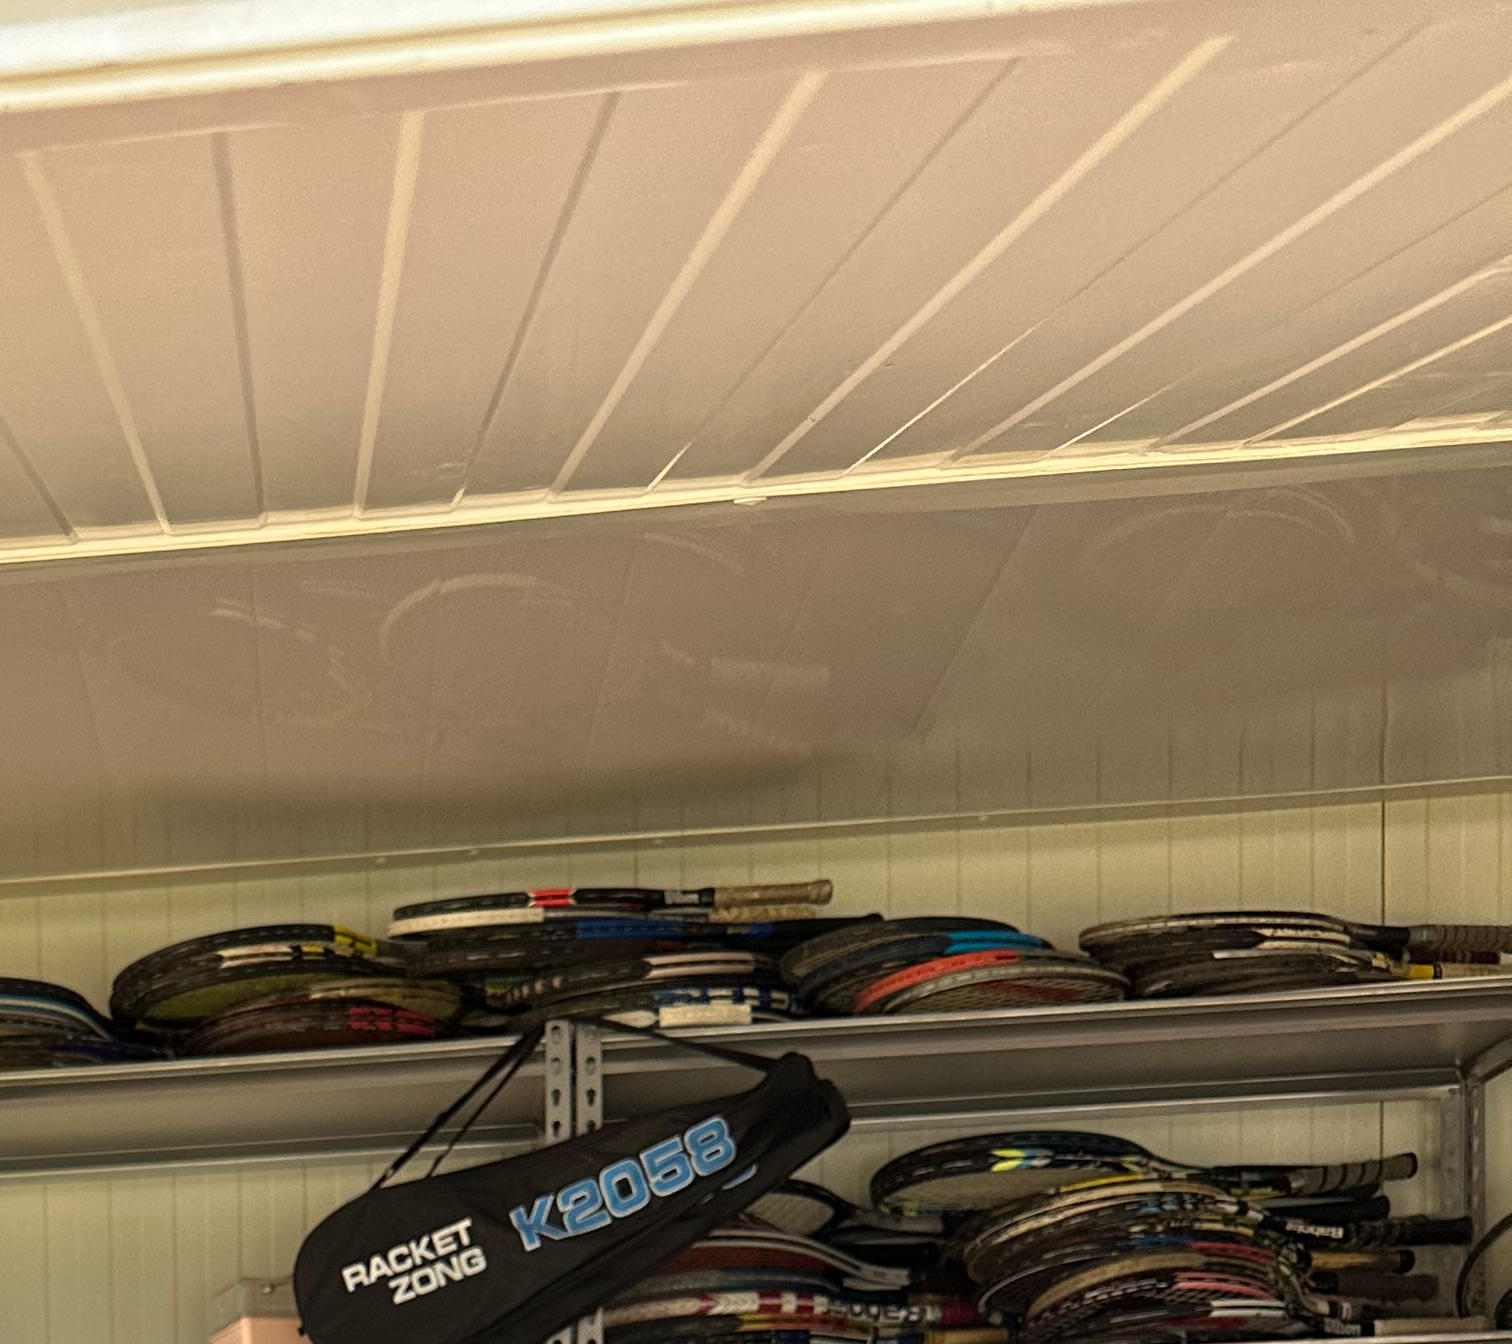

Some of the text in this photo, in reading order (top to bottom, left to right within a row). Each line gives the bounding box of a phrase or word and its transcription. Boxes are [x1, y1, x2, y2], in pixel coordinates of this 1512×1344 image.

[509, 1115, 737, 1252] K2058
[340, 1217, 473, 1293] RACKET
[389, 1245, 488, 1305] ZONG
